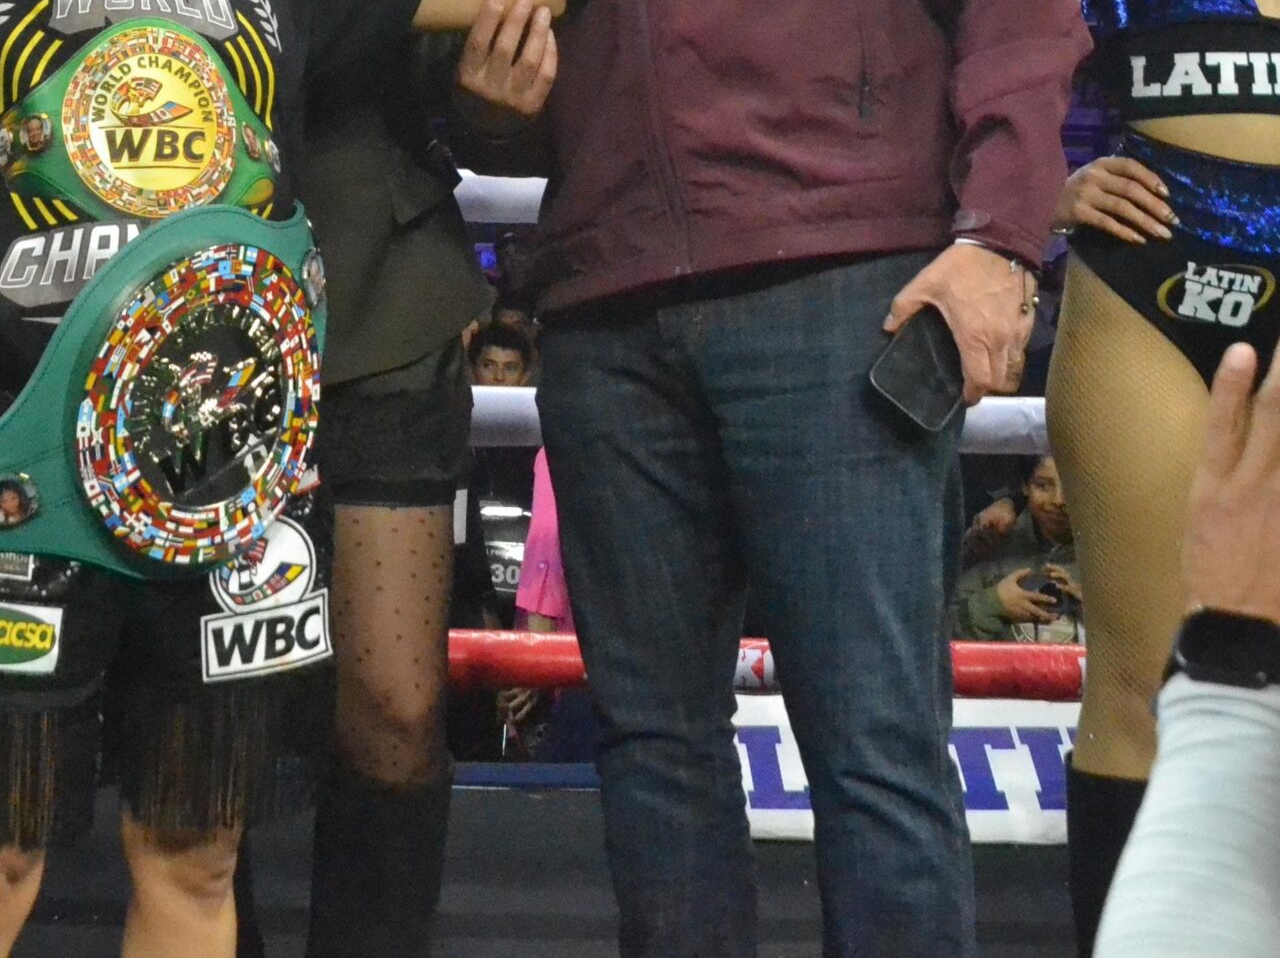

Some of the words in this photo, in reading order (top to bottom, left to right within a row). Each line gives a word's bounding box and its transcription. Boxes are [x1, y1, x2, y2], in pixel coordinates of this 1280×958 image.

[91, 62, 132, 123] WORLD
[137, 55, 214, 123] CHAMPION
[1130, 52, 1280, 97] LATI
[105, 128, 206, 163] WBC
[1184, 261, 1262, 294] LATIN
[1178, 280, 1255, 328] KO
[211, 605, 321, 668] WBC
